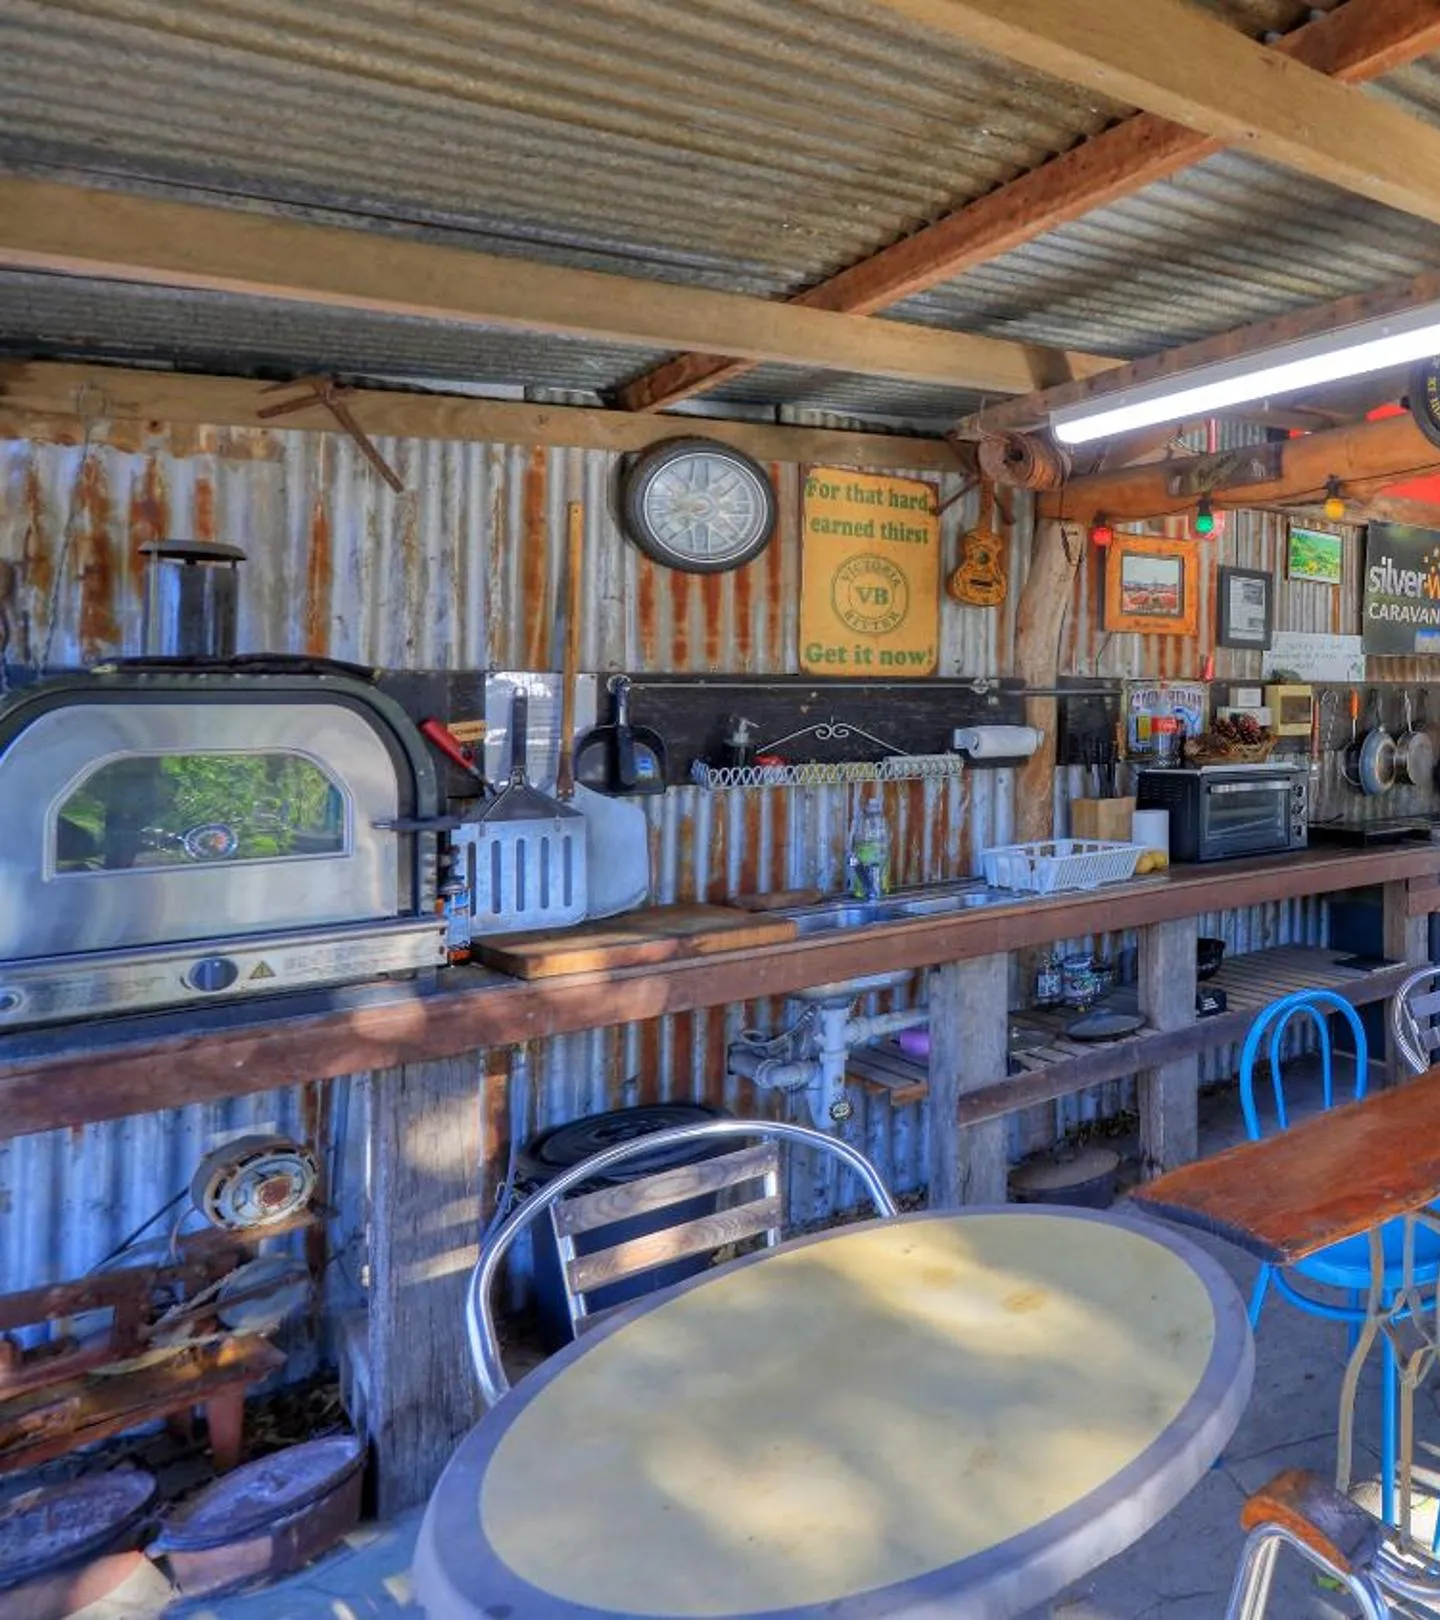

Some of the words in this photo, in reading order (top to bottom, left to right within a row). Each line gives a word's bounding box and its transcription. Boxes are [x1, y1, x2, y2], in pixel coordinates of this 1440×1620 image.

[805, 477, 841, 500] For
[846, 482, 884, 506] that
[889, 487, 928, 512] hard
[810, 515, 875, 538] earned
[880, 520, 929, 545] thirst
[855, 586, 889, 605] VB
[1369, 603, 1440, 625] CARAVAN
[805, 642, 847, 665] Get
[855, 644, 873, 665] it
[879, 648, 933, 666] now!
